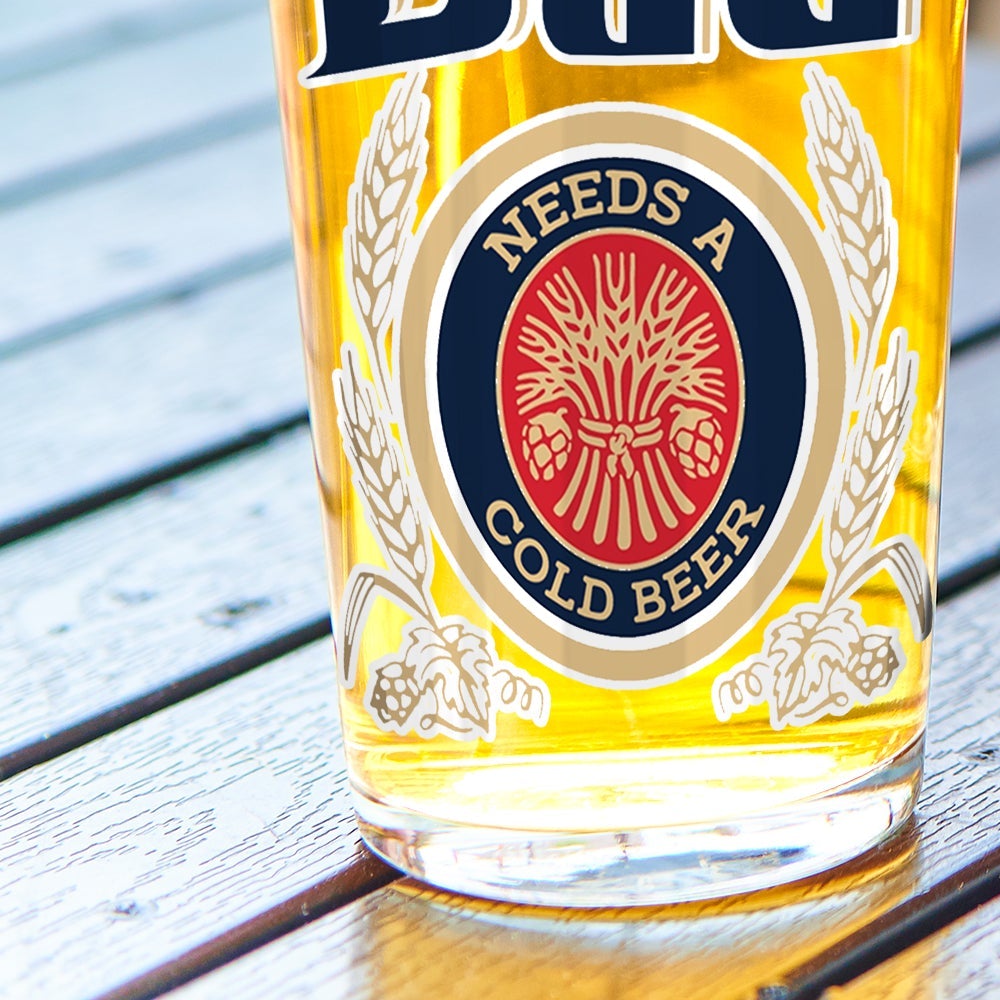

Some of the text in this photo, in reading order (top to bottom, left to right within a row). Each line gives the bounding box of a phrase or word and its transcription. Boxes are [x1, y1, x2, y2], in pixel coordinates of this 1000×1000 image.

[482, 168, 736, 274] NEEDS A
[485, 498, 766, 624] COLD BEER
